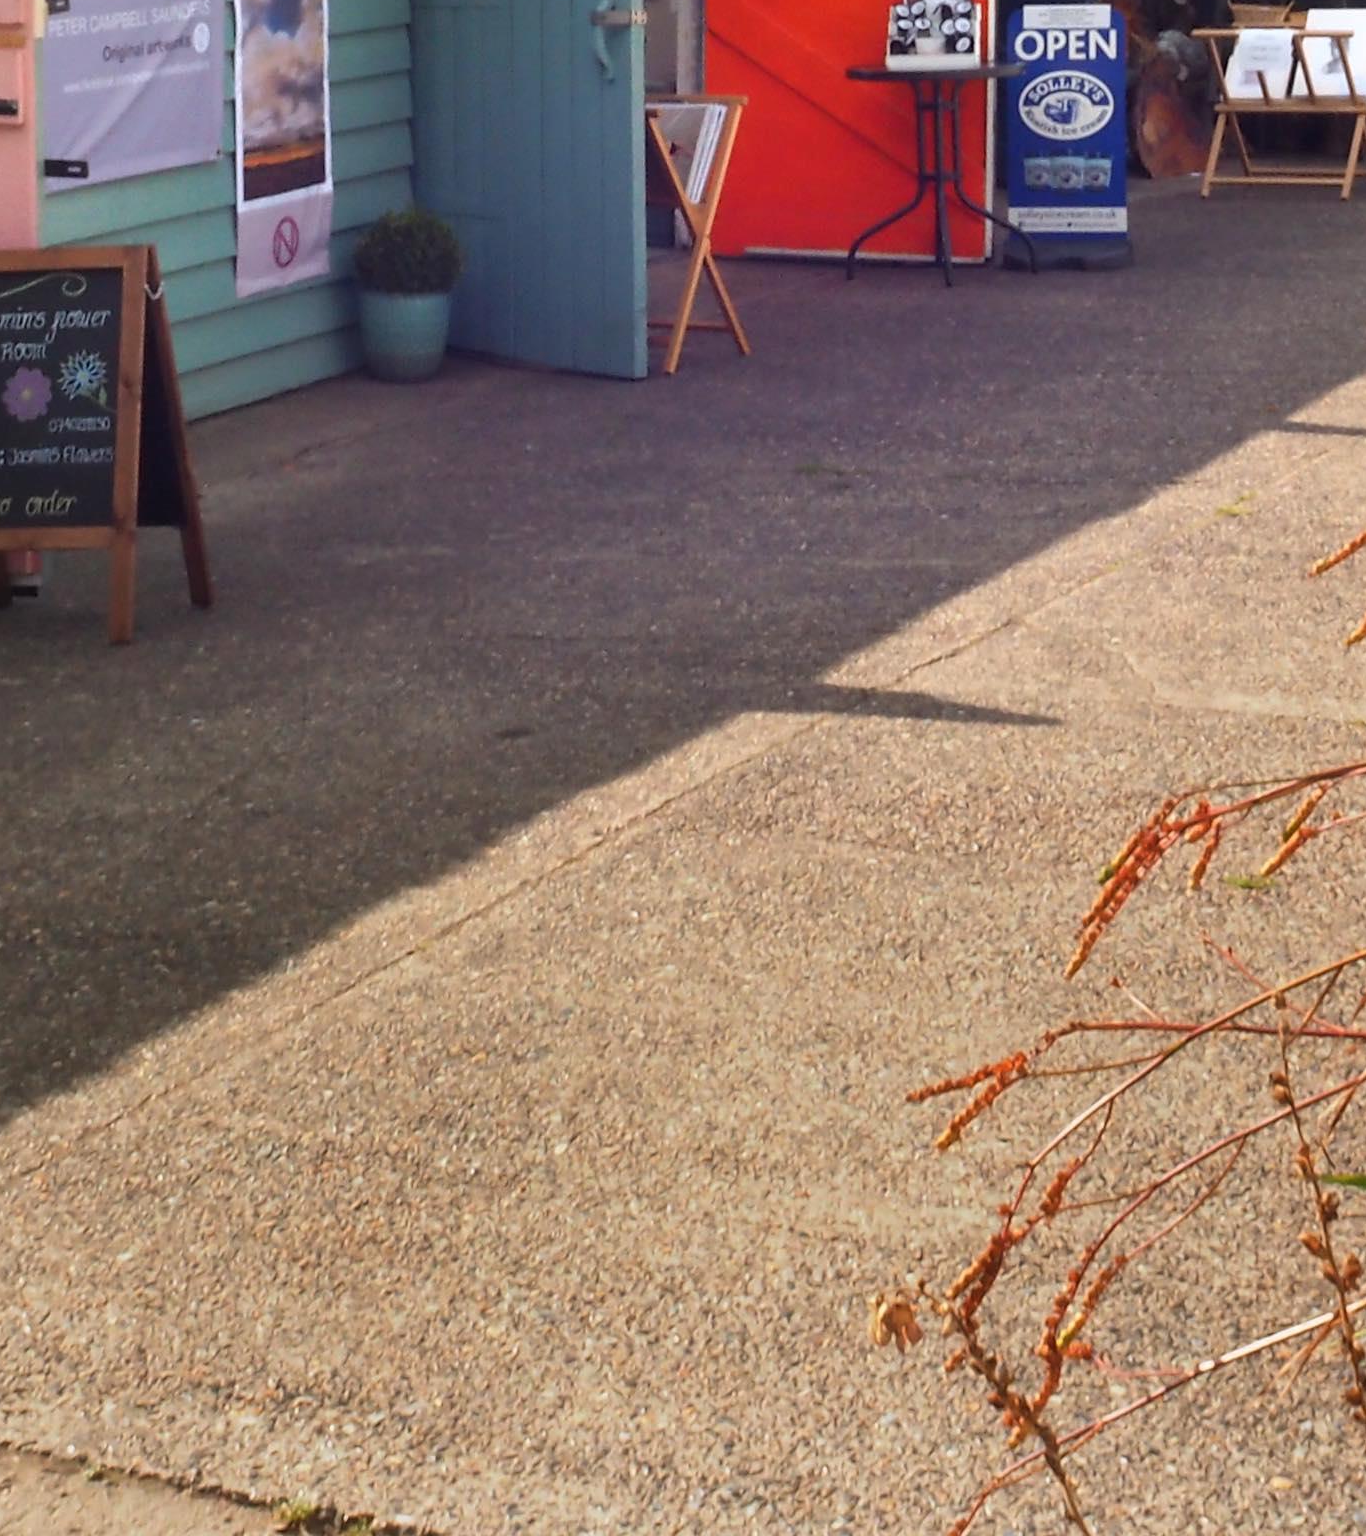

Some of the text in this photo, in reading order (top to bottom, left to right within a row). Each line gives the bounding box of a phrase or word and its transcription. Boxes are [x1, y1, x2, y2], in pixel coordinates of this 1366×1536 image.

[47, 15, 87, 38] PETER
[90, 9, 148, 33] CAMPBELL
[102, 41, 145, 64] Original
[1014, 29, 1117, 61] OPEN
[1027, 76, 1105, 104] SOLLEY'S
[25, 489, 77, 515] order
